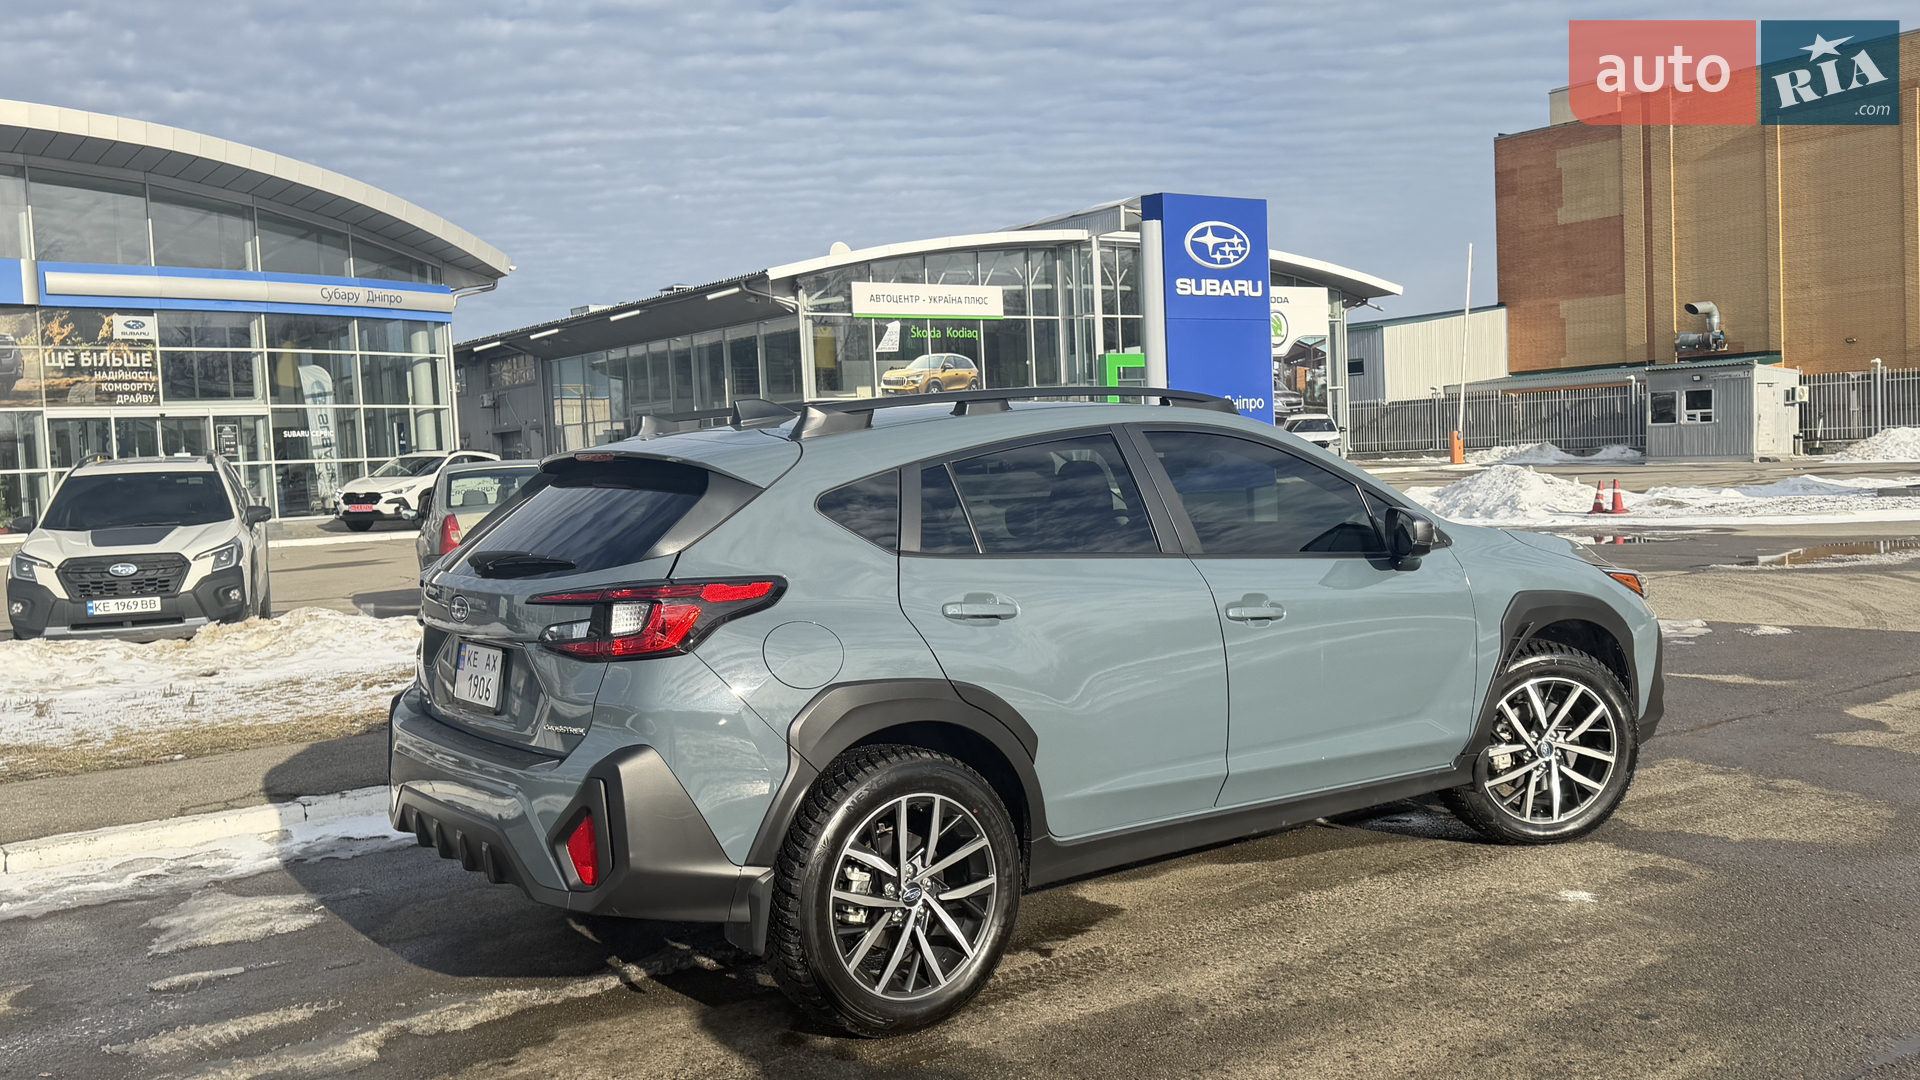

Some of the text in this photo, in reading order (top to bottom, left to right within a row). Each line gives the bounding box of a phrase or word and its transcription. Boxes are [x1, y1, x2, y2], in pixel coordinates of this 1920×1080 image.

[1175, 278, 1263, 297] SUBARU
[320, 287, 403, 306] Субару Дніпро
[869, 294, 920, 304] АВТОЦЕНТР
[928, 294, 963, 305] УКРАЇНА
[964, 296, 989, 305] ПЛЮС
[1271, 296, 1290, 304] ODA
[910, 325, 942, 339] Škoda
[946, 326, 979, 340] Kodiaq
[44, 352, 152, 370] ЩЕ БІЛЬШЕ
[101, 382, 157, 393] КОМФОРТУ,
[116, 393, 155, 404] ДРАЙВУ
[282, 430, 310, 438] SUBARU
[94, 599, 157, 613] KE 1969 BB
[466, 650, 478, 668] KE
[484, 654, 499, 672] AX
[468, 673, 493, 701] 1906
[845, 771, 898, 814] NEXEN
